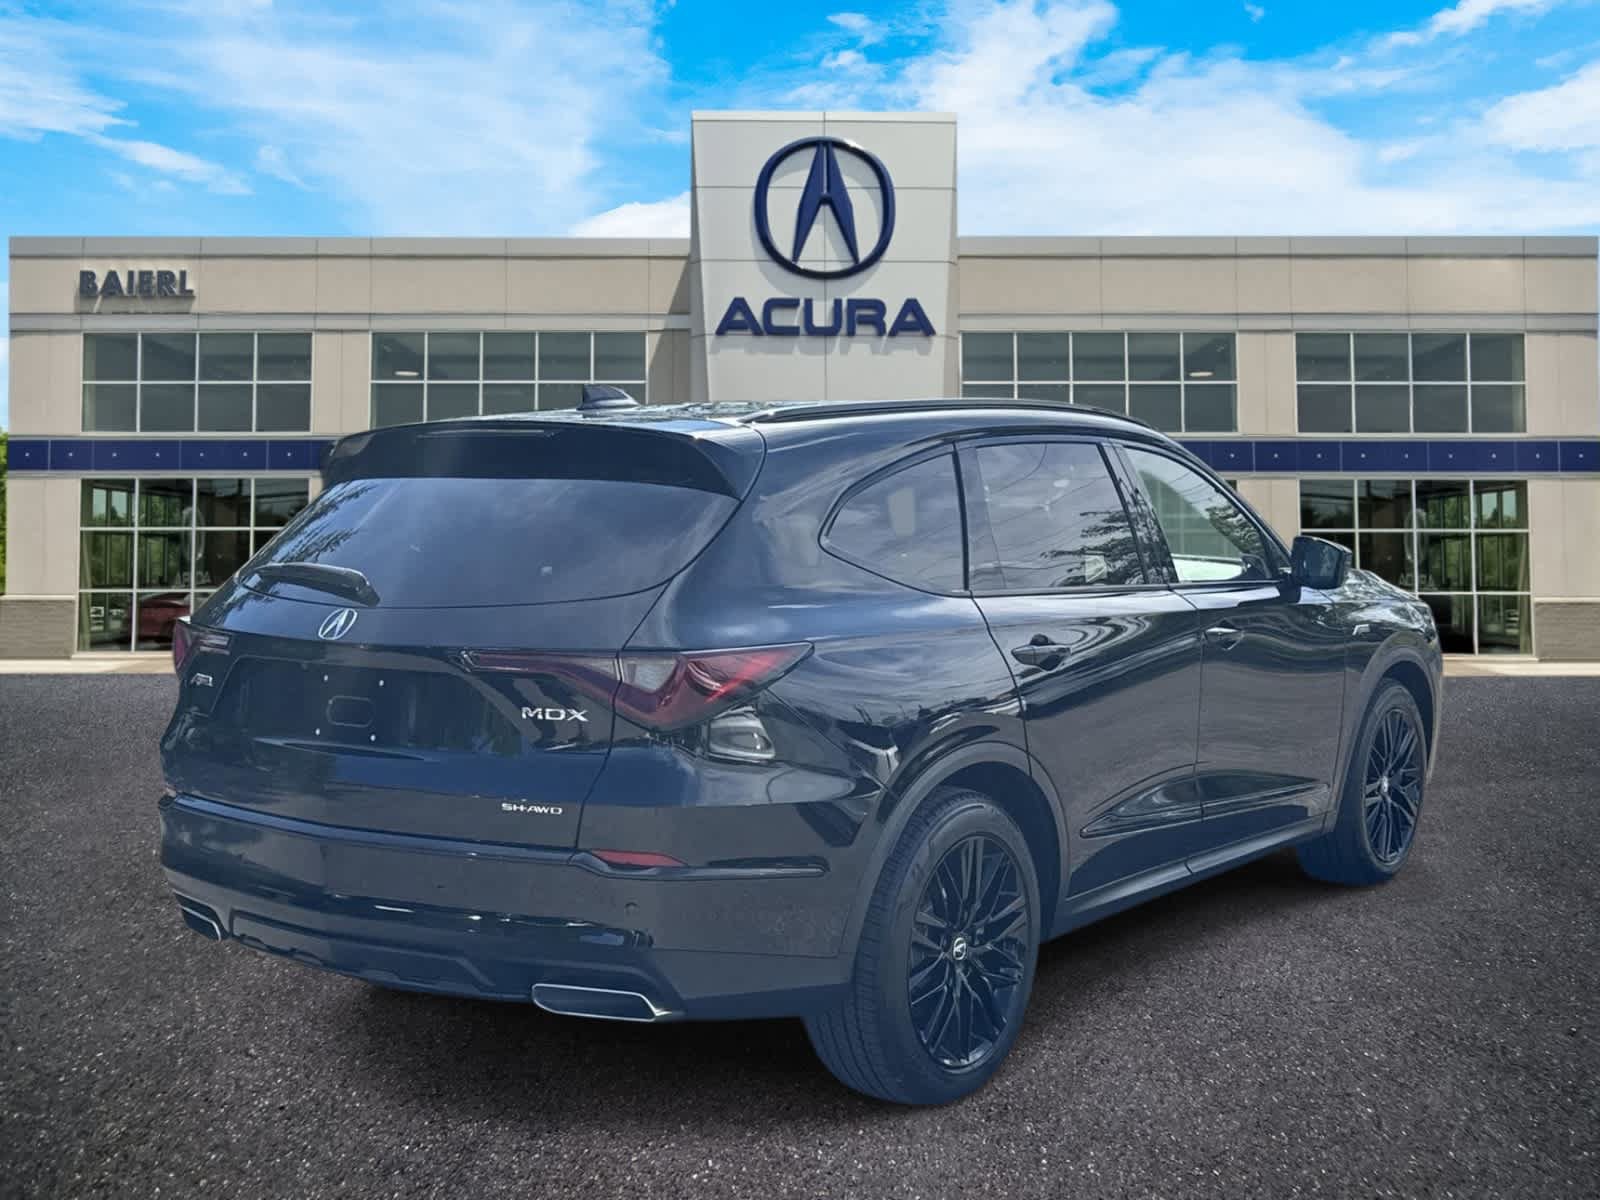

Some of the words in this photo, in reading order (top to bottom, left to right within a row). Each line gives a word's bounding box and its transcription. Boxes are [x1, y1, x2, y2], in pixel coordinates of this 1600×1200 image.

[79, 270, 194, 297] BAIERL
[715, 297, 937, 337] ACURA
[521, 706, 589, 722] MDX
